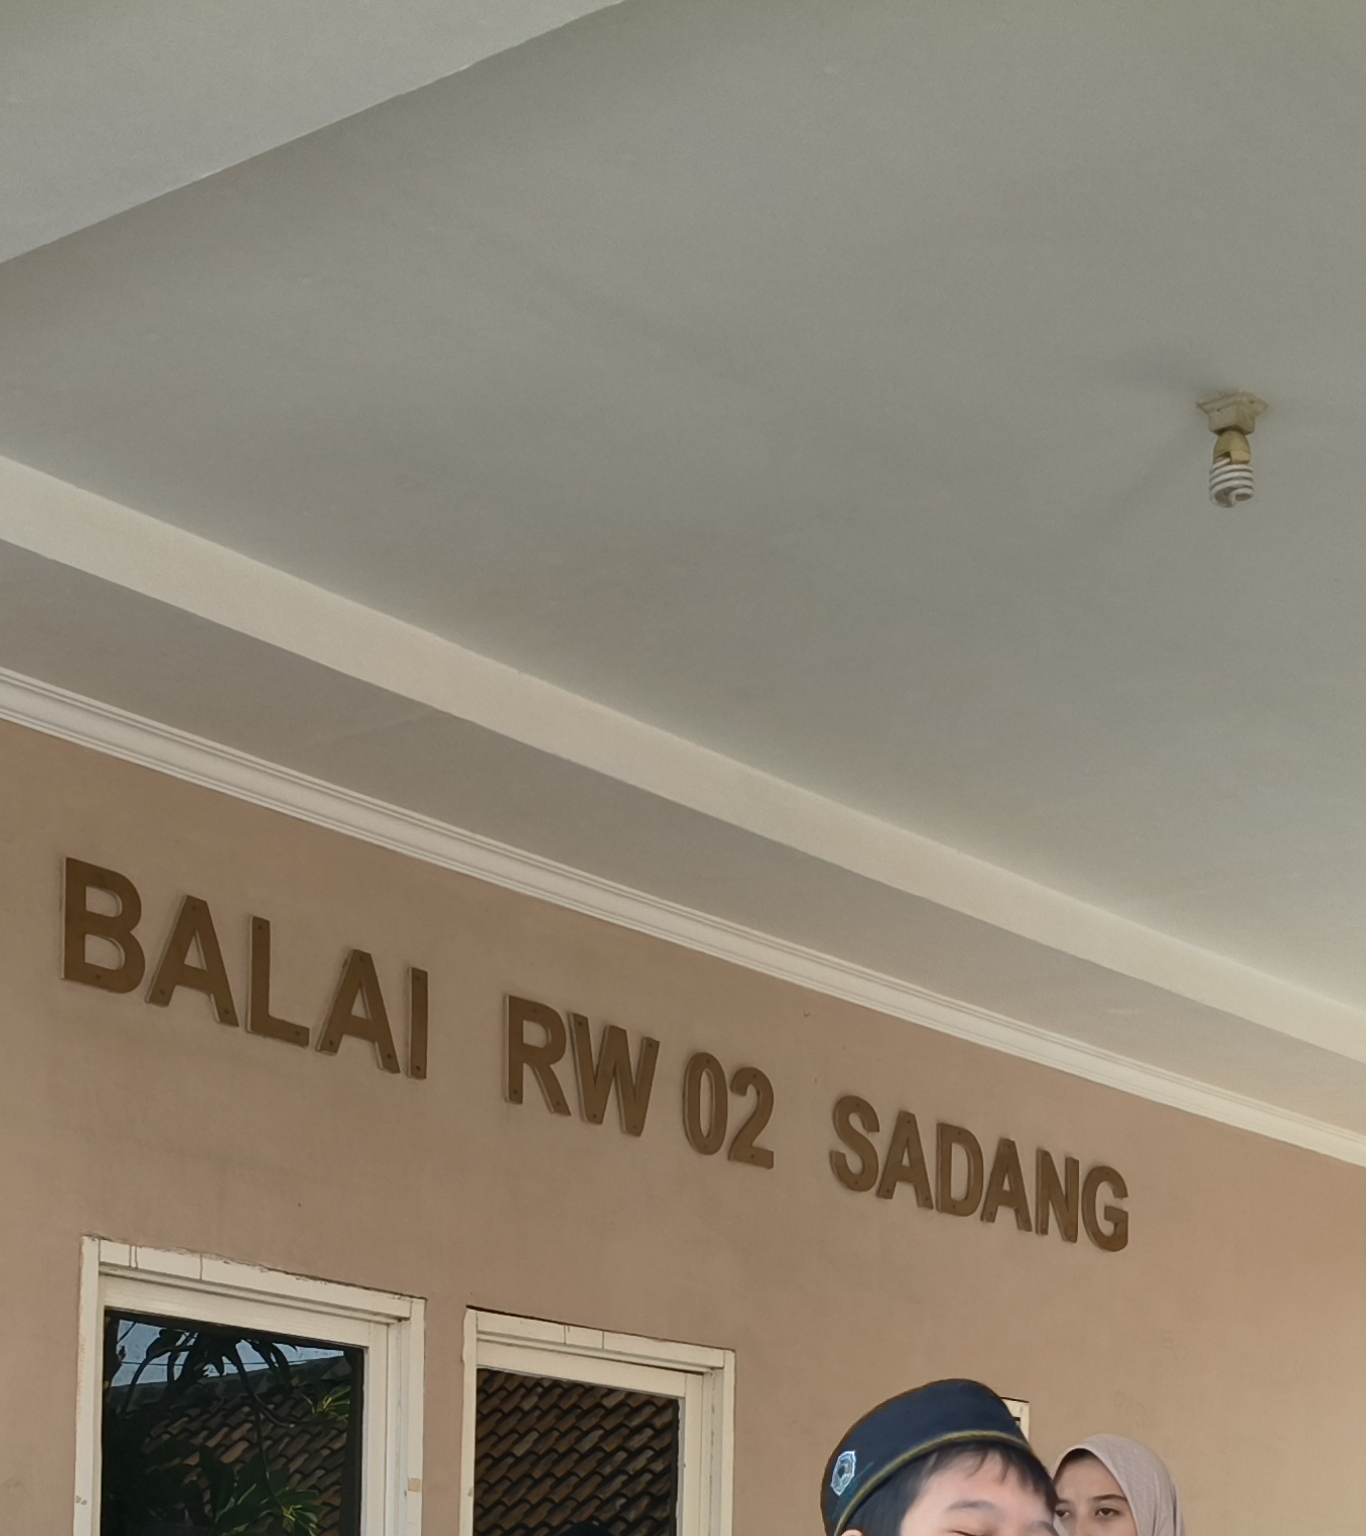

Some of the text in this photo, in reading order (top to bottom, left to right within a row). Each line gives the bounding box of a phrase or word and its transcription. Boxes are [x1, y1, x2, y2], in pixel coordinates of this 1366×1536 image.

[61, 857, 1130, 1252] BALAI RW 02 SADANG
